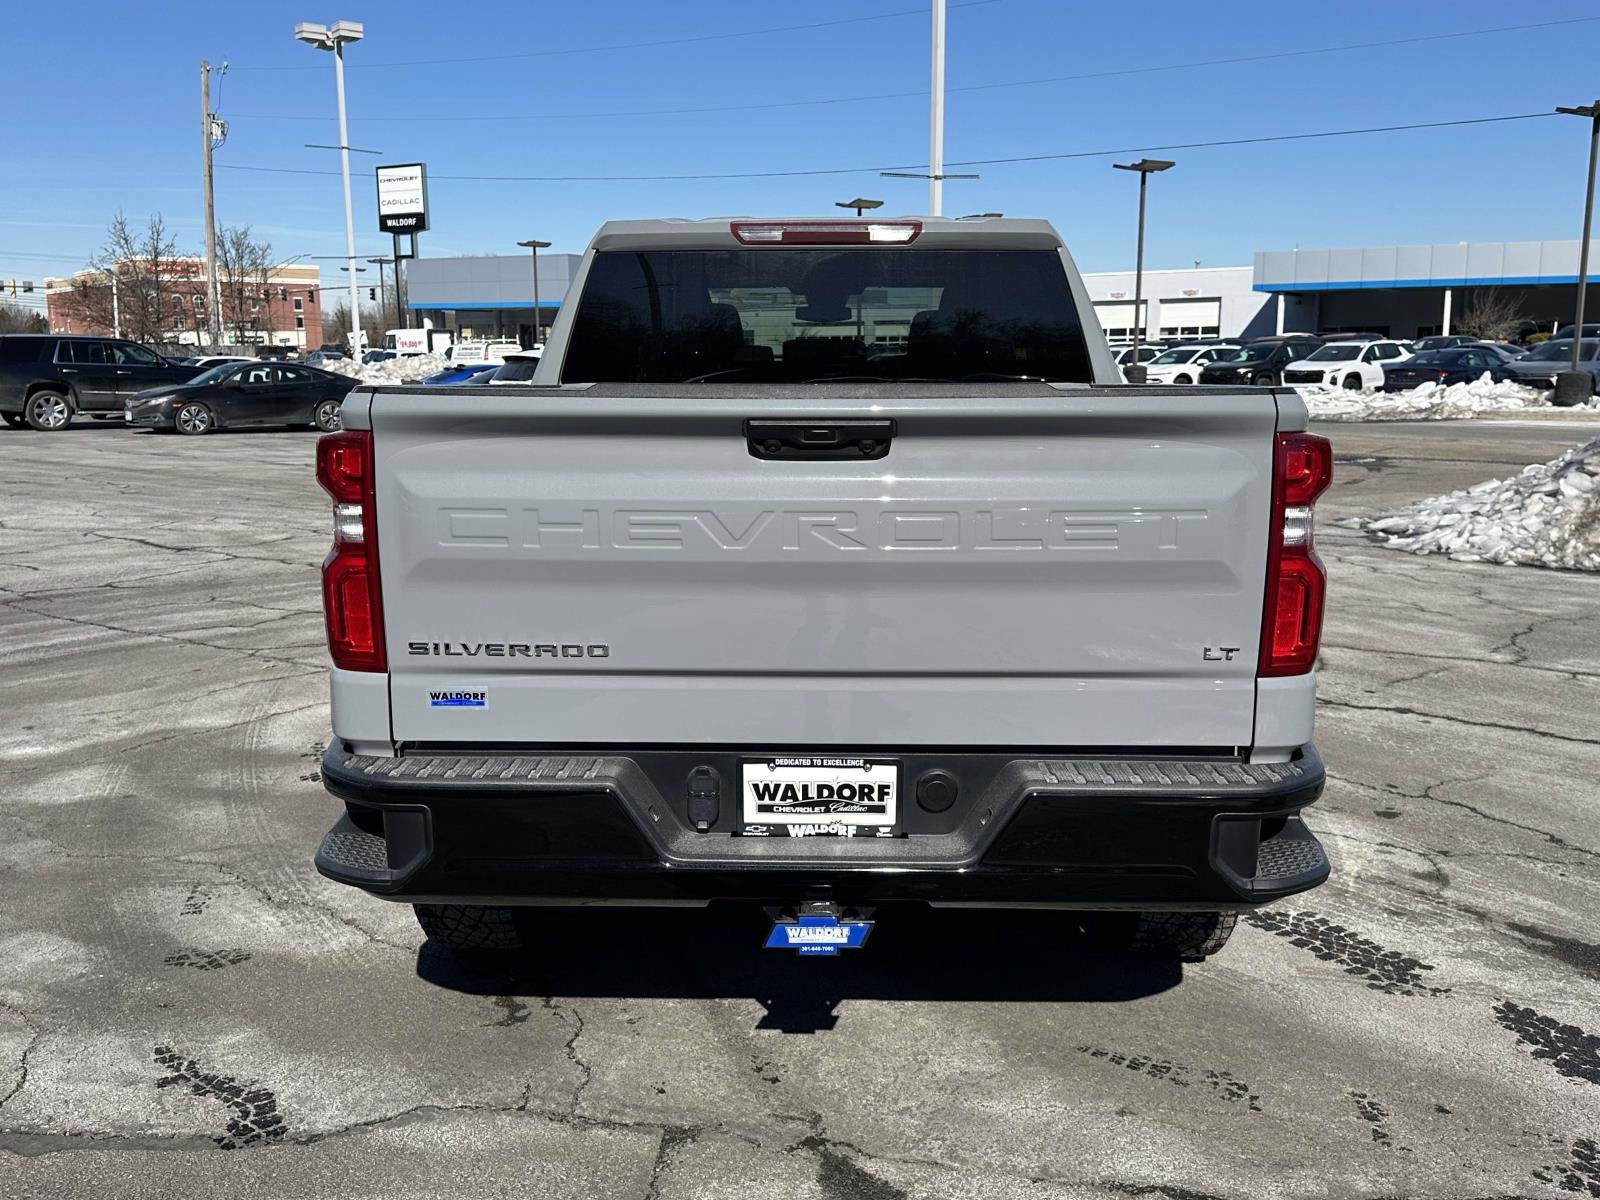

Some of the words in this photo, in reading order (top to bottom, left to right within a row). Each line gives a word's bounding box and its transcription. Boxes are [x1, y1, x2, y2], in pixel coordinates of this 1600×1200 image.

[381, 198, 420, 206] CADILLAC
[386, 218, 416, 226] WALDORF
[437, 507, 1208, 550] CHEVROLET
[408, 642, 609, 657] SILVERADO
[1203, 647, 1240, 661] LT
[430, 692, 486, 700] WALDORF
[775, 758, 811, 766] DEDICATED
[751, 783, 891, 803] WALDORF
[829, 802, 868, 813] Cadillac
[787, 825, 857, 838] WALDORF
[786, 927, 850, 938] WALDORF
